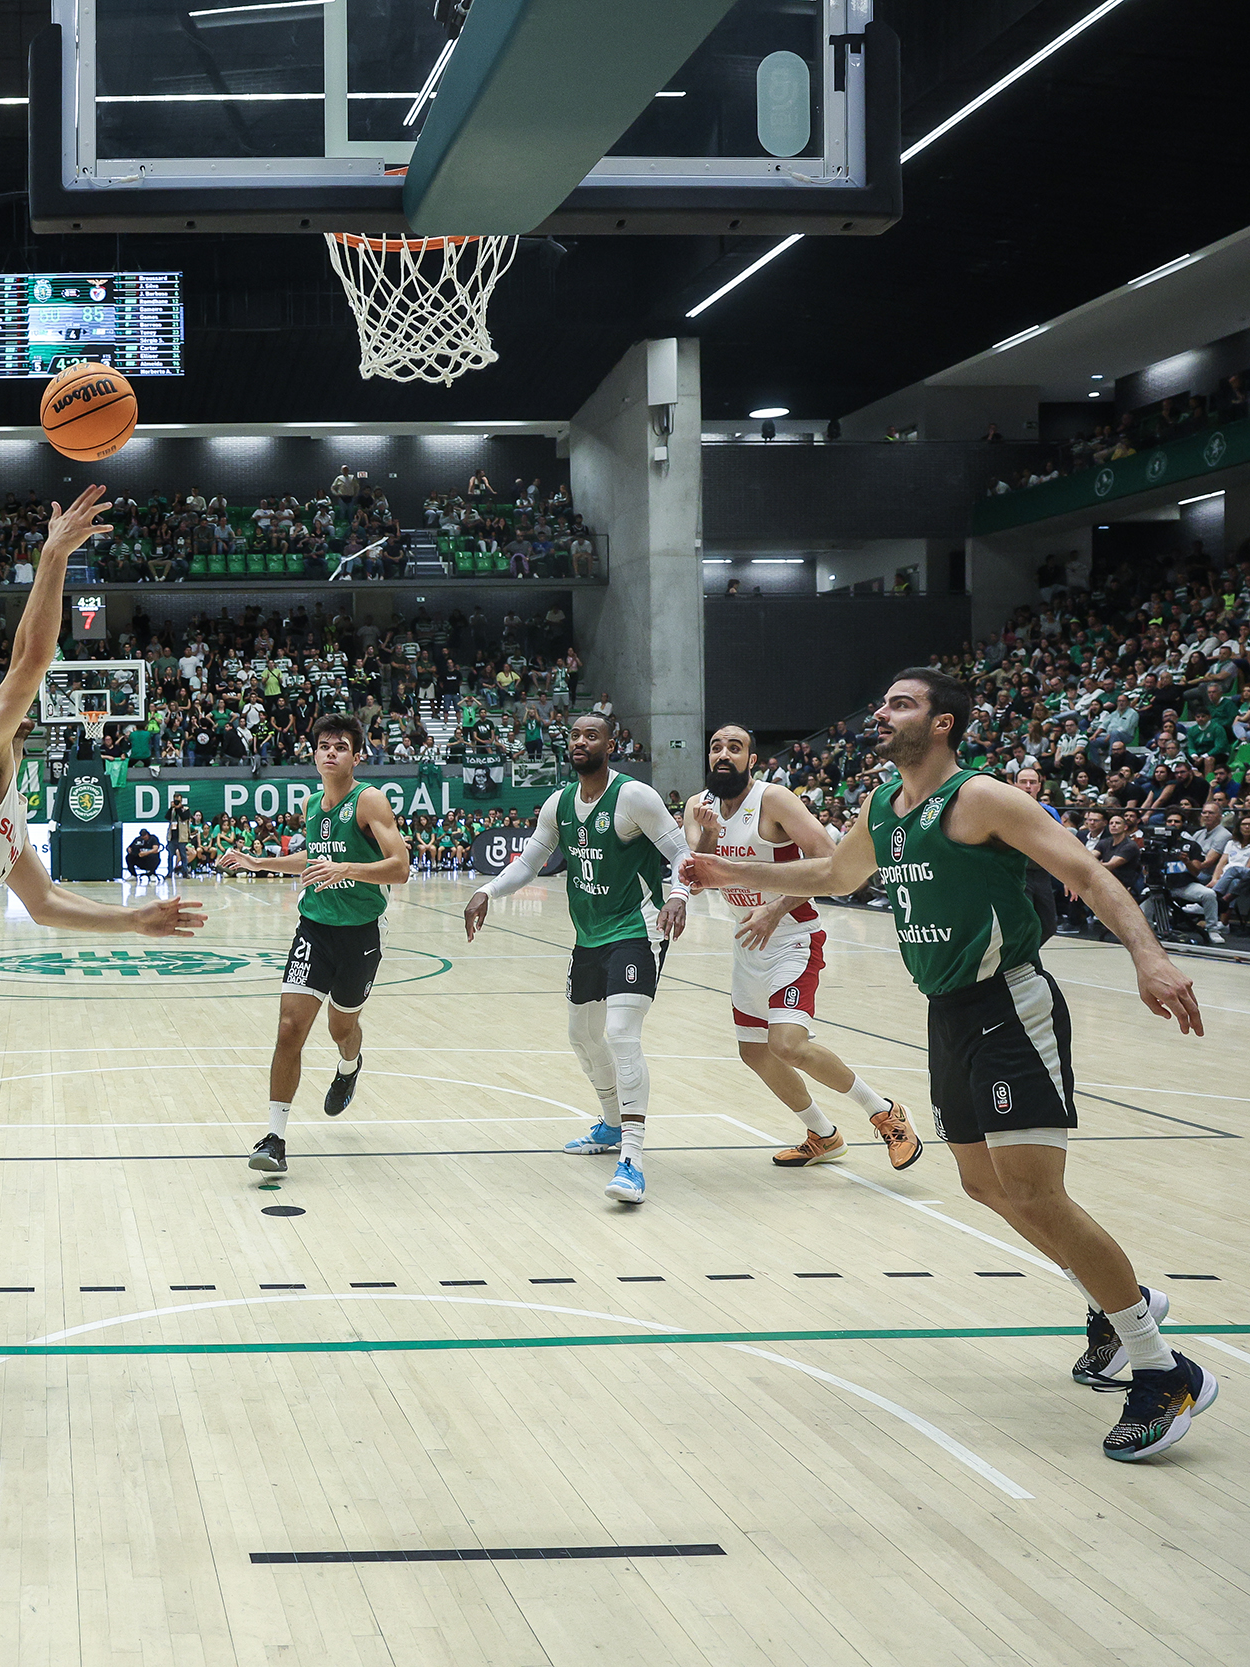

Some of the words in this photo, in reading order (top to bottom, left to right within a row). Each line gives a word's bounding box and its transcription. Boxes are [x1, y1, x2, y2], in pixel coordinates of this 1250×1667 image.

[82, 306, 105, 322] 85
[51, 378, 118, 414] Wilson
[77, 596, 101, 607] 4:21
[81, 611, 96, 630] 7
[74, 776, 99, 785] SCP
[224, 783, 456, 816] PORGAL
[308, 841, 347, 854] SPORTING
[715, 845, 757, 858] ENFICA
[580, 858, 594, 882] 10
[879, 862, 934, 885] SPORTING
[896, 884, 912, 924] 9
[898, 923, 952, 944] uditiv
[293, 936, 312, 962] 21
[288, 968, 309, 978] QUILI
[290, 960, 312, 971] TRAN
[286, 976, 307, 986] DADE
